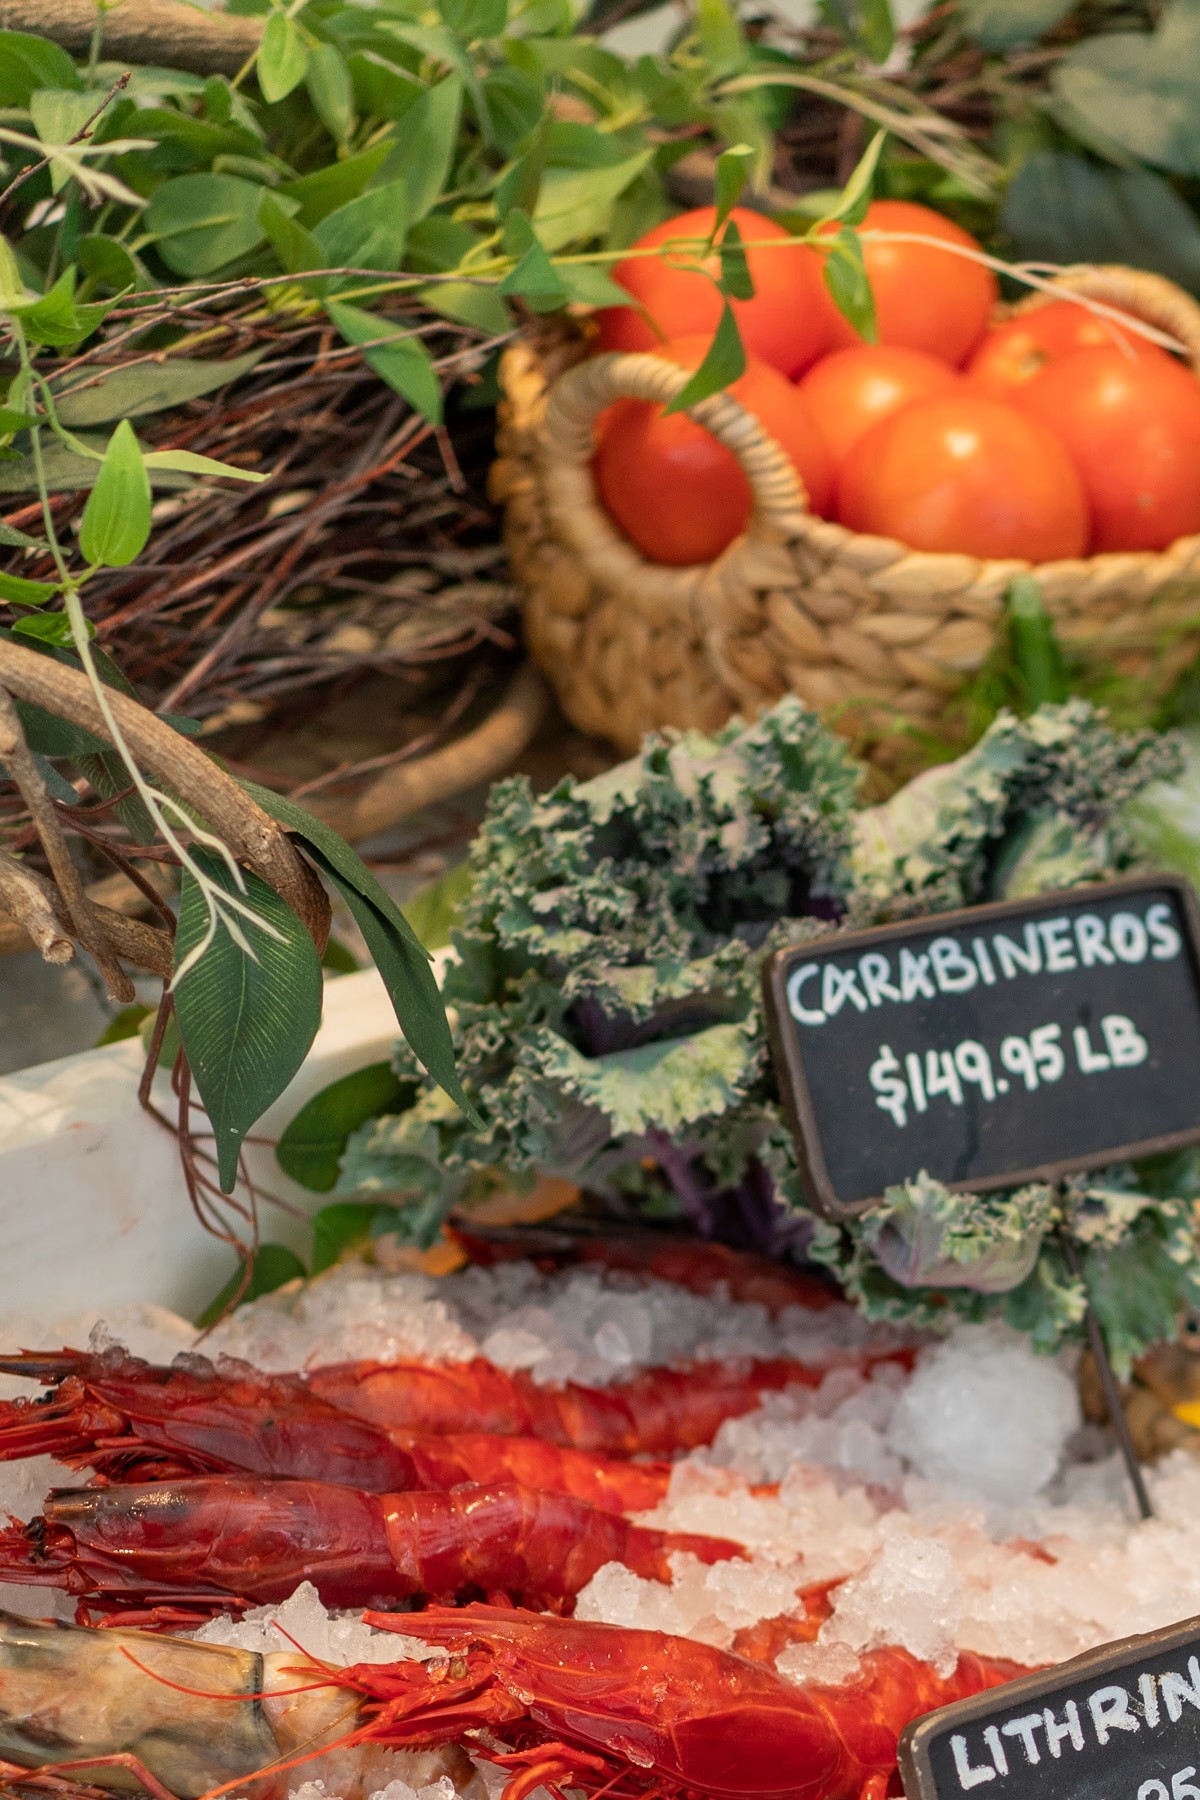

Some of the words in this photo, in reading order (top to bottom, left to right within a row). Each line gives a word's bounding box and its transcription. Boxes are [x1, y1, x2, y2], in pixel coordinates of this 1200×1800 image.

[787, 903, 1181, 1026] CARABINEROS
[868, 1022, 1065, 1128] $149.95
[1073, 1013, 1149, 1074] LB
